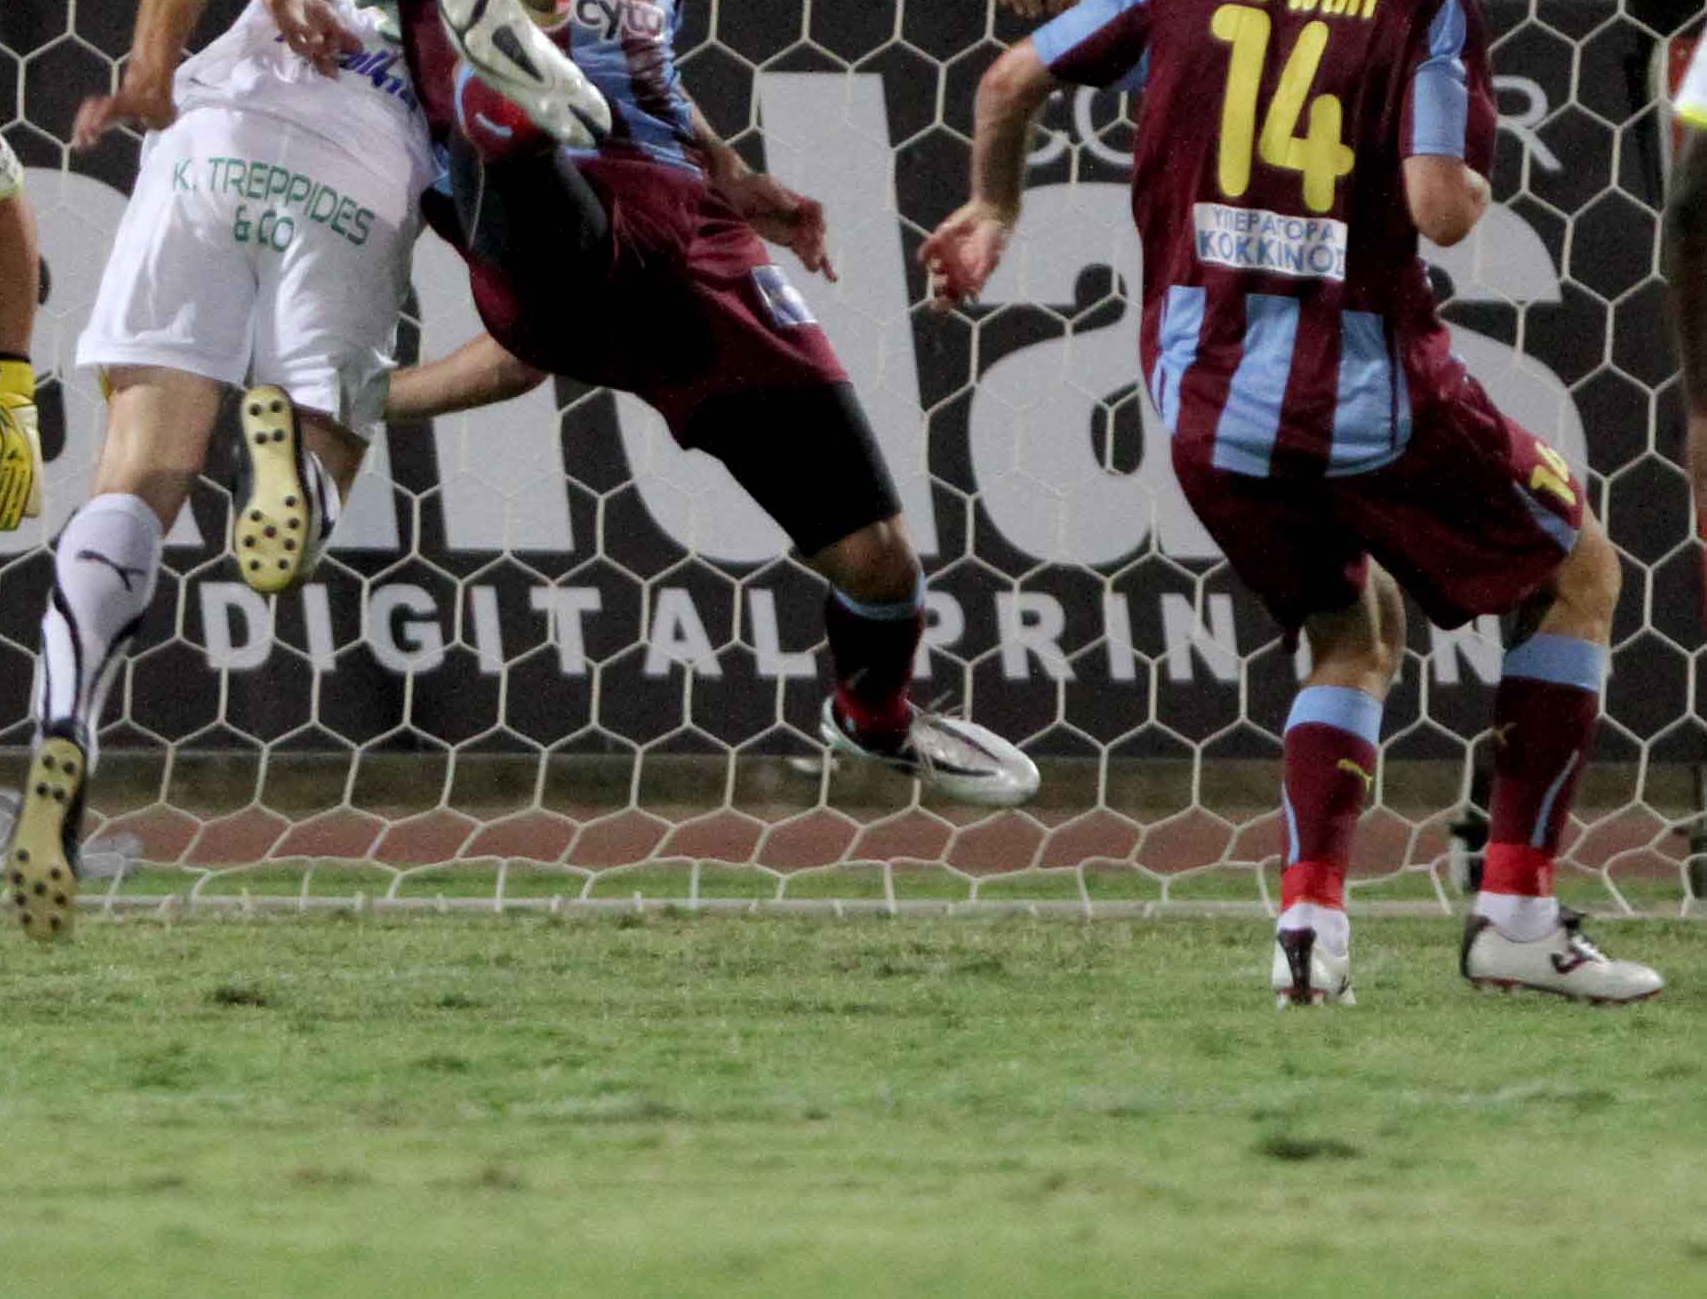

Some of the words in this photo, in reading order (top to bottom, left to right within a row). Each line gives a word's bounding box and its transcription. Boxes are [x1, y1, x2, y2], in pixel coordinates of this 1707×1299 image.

[1210, 3, 1356, 213] 14
[208, 156, 376, 246] TREPPIDES
[233, 204, 253, 242] &
[257, 209, 294, 253] CO
[198, 581, 819, 678] DIGITAL
[910, 590, 1609, 682] PRINN
